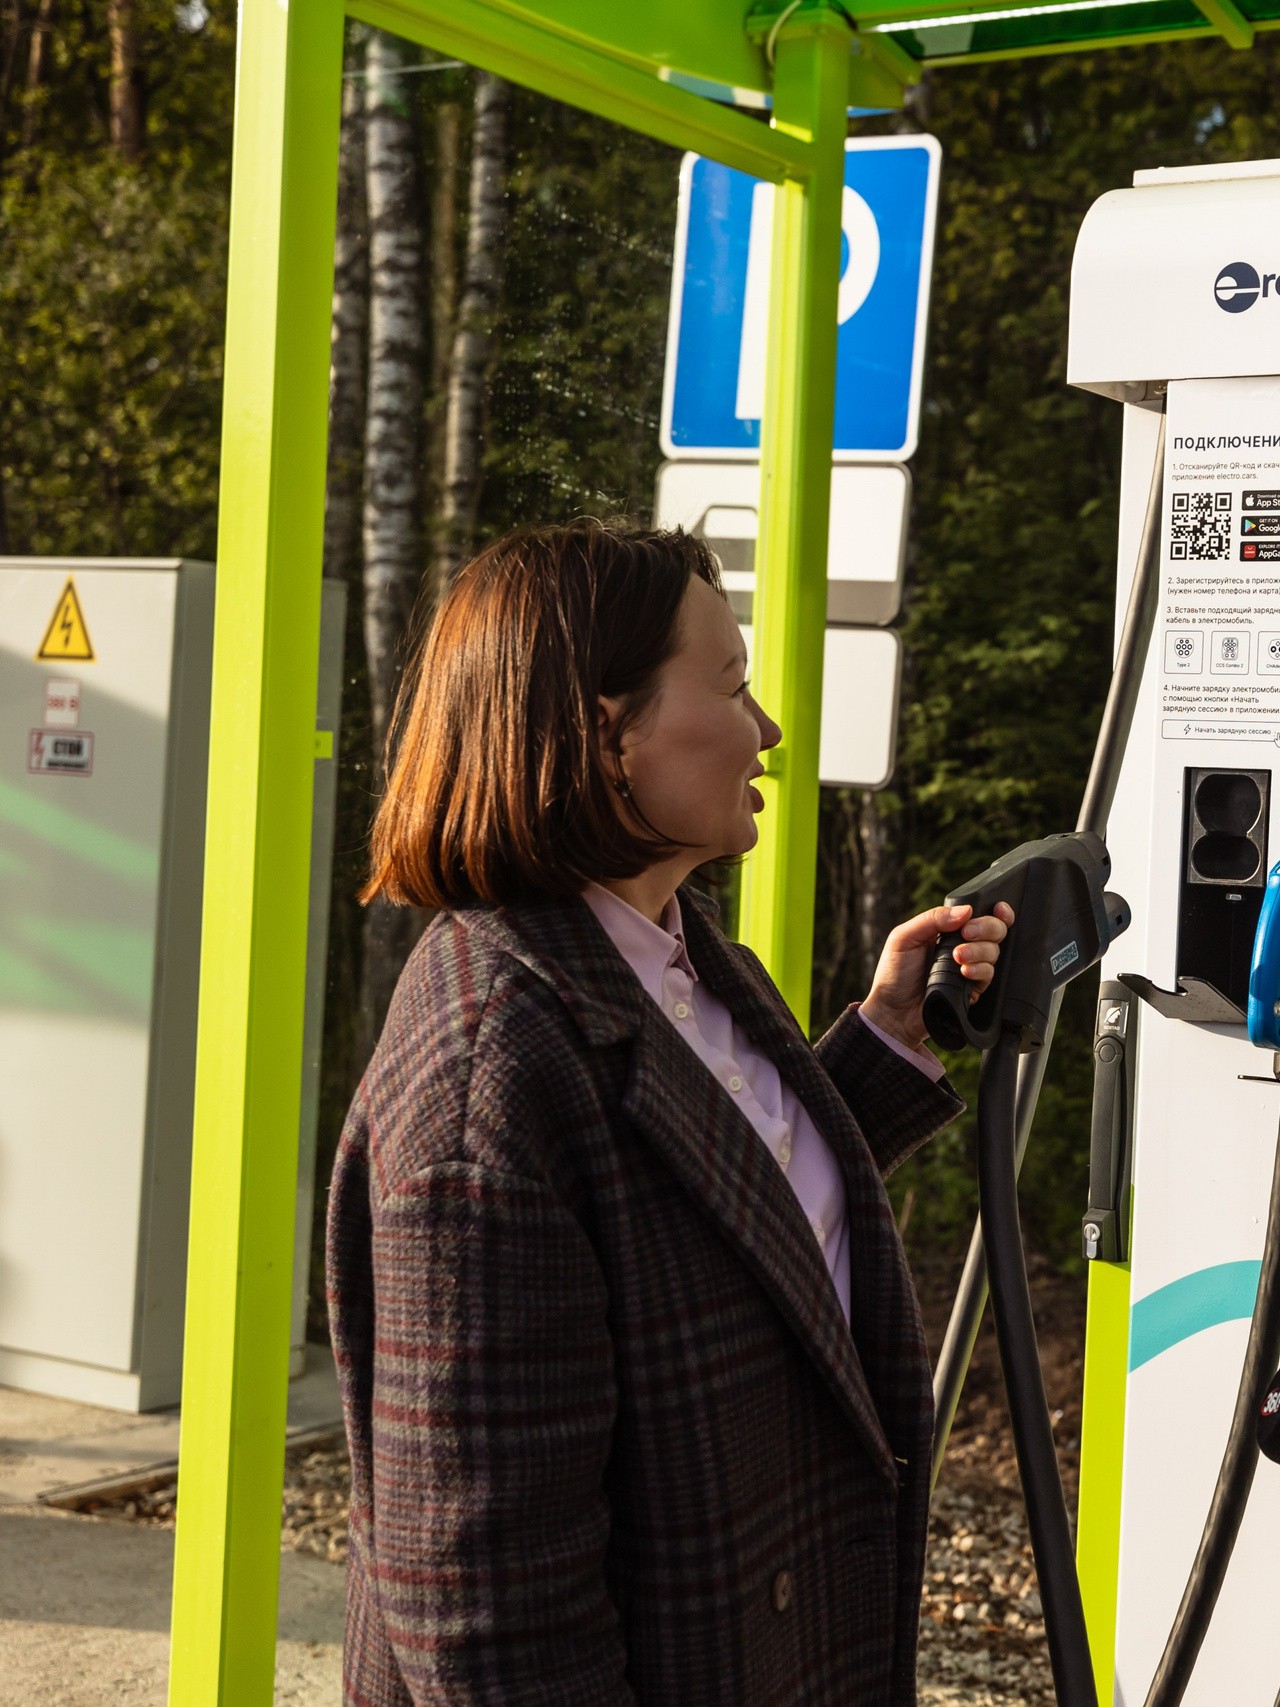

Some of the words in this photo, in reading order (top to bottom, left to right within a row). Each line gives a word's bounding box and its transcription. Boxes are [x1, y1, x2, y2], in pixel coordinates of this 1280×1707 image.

[1179, 462, 1228, 471] Отсканируйте
[1230, 462, 1255, 470] QR-код
[1172, 474, 1215, 482] приложение
[1216, 472, 1258, 480] electro.cars.
[1256, 497, 1272, 508] App
[1168, 576, 1174, 584] 2.
[1176, 576, 1244, 586] Зарегистрируйтесь
[1168, 587, 1192, 596] (нужен
[1218, 587, 1251, 595] телефона
[1167, 606, 1173, 614] 3.
[1175, 606, 1206, 614] Вставьте
[1208, 606, 1252, 614] подходящий
[1166, 616, 1190, 624] кабель
[1198, 616, 1254, 625] электромобиль.
[1172, 684, 1200, 692] Начните
[1202, 686, 1230, 694] зарядку
[1169, 695, 1203, 703] помощью
[1230, 695, 1259, 703] «Начать
[1163, 705, 1196, 714] зарядную
